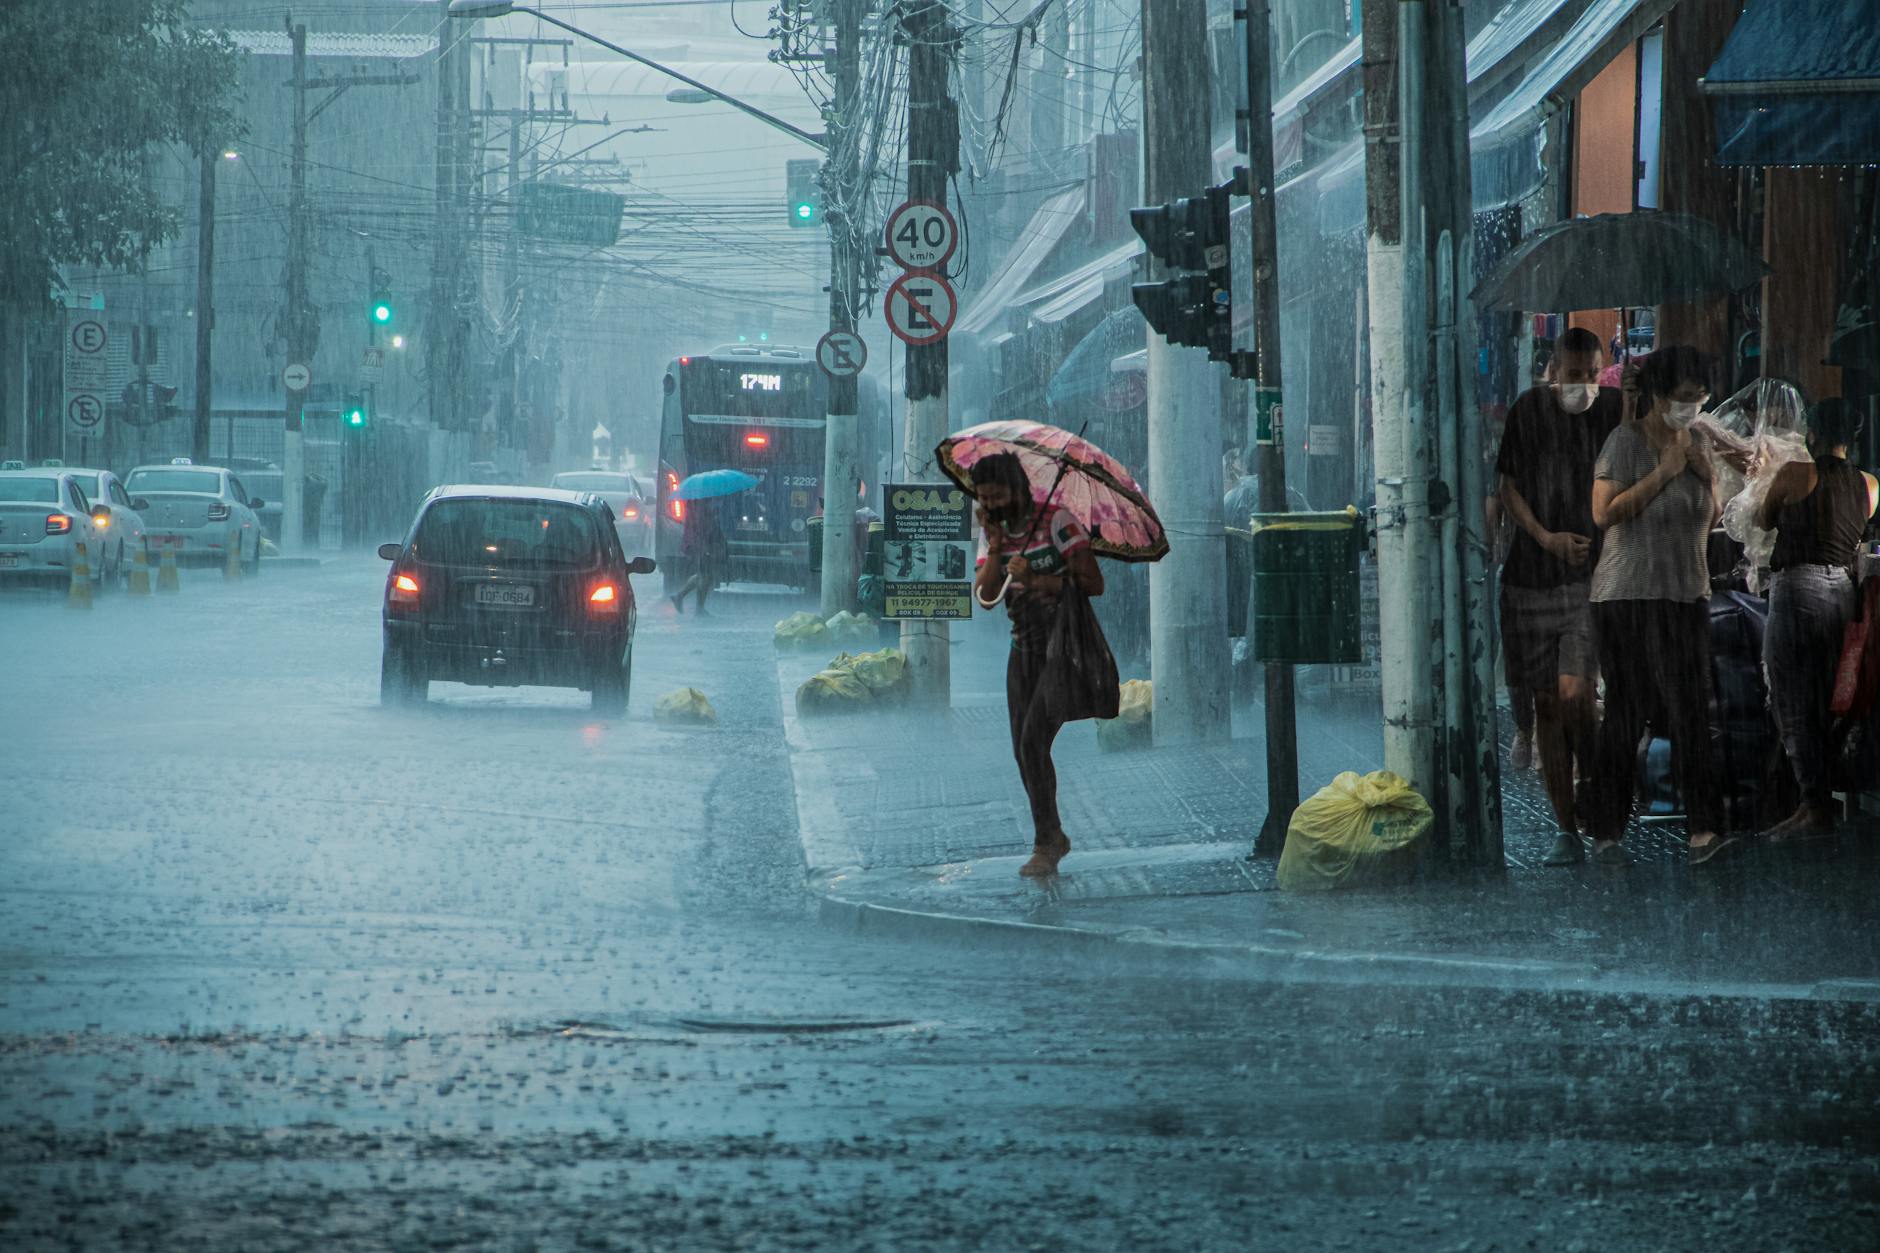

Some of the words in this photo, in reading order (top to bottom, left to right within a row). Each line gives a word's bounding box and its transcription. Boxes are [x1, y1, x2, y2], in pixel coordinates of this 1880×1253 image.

[896, 216, 945, 248] 40
[909, 251, 935, 260] km/h
[908, 289, 932, 329] E
[84, 328, 96, 346] E
[833, 340, 851, 368] E
[740, 374, 781, 390] 174M
